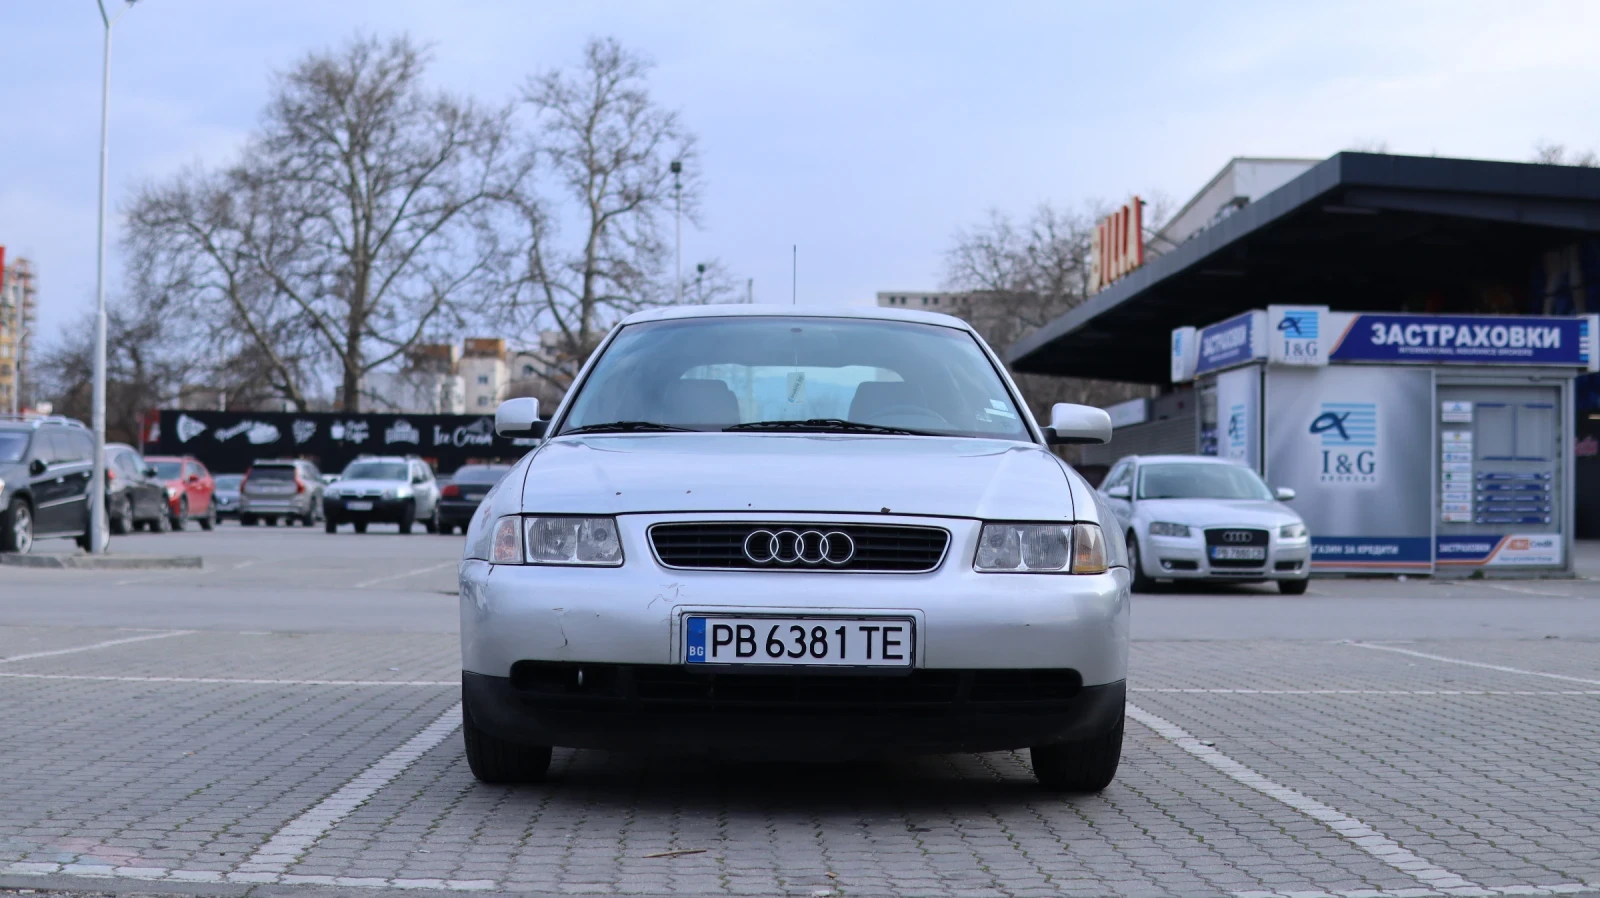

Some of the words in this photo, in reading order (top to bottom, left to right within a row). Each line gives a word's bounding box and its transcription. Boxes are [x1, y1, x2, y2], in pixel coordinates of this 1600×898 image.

[1370, 322, 1561, 349] ЗАСТРАХОВКИ
[1321, 449, 1376, 475] I&G
[689, 645, 704, 657] BG
[712, 624, 757, 658] PB
[765, 625, 847, 659] 6381
[859, 626, 904, 660] TE
